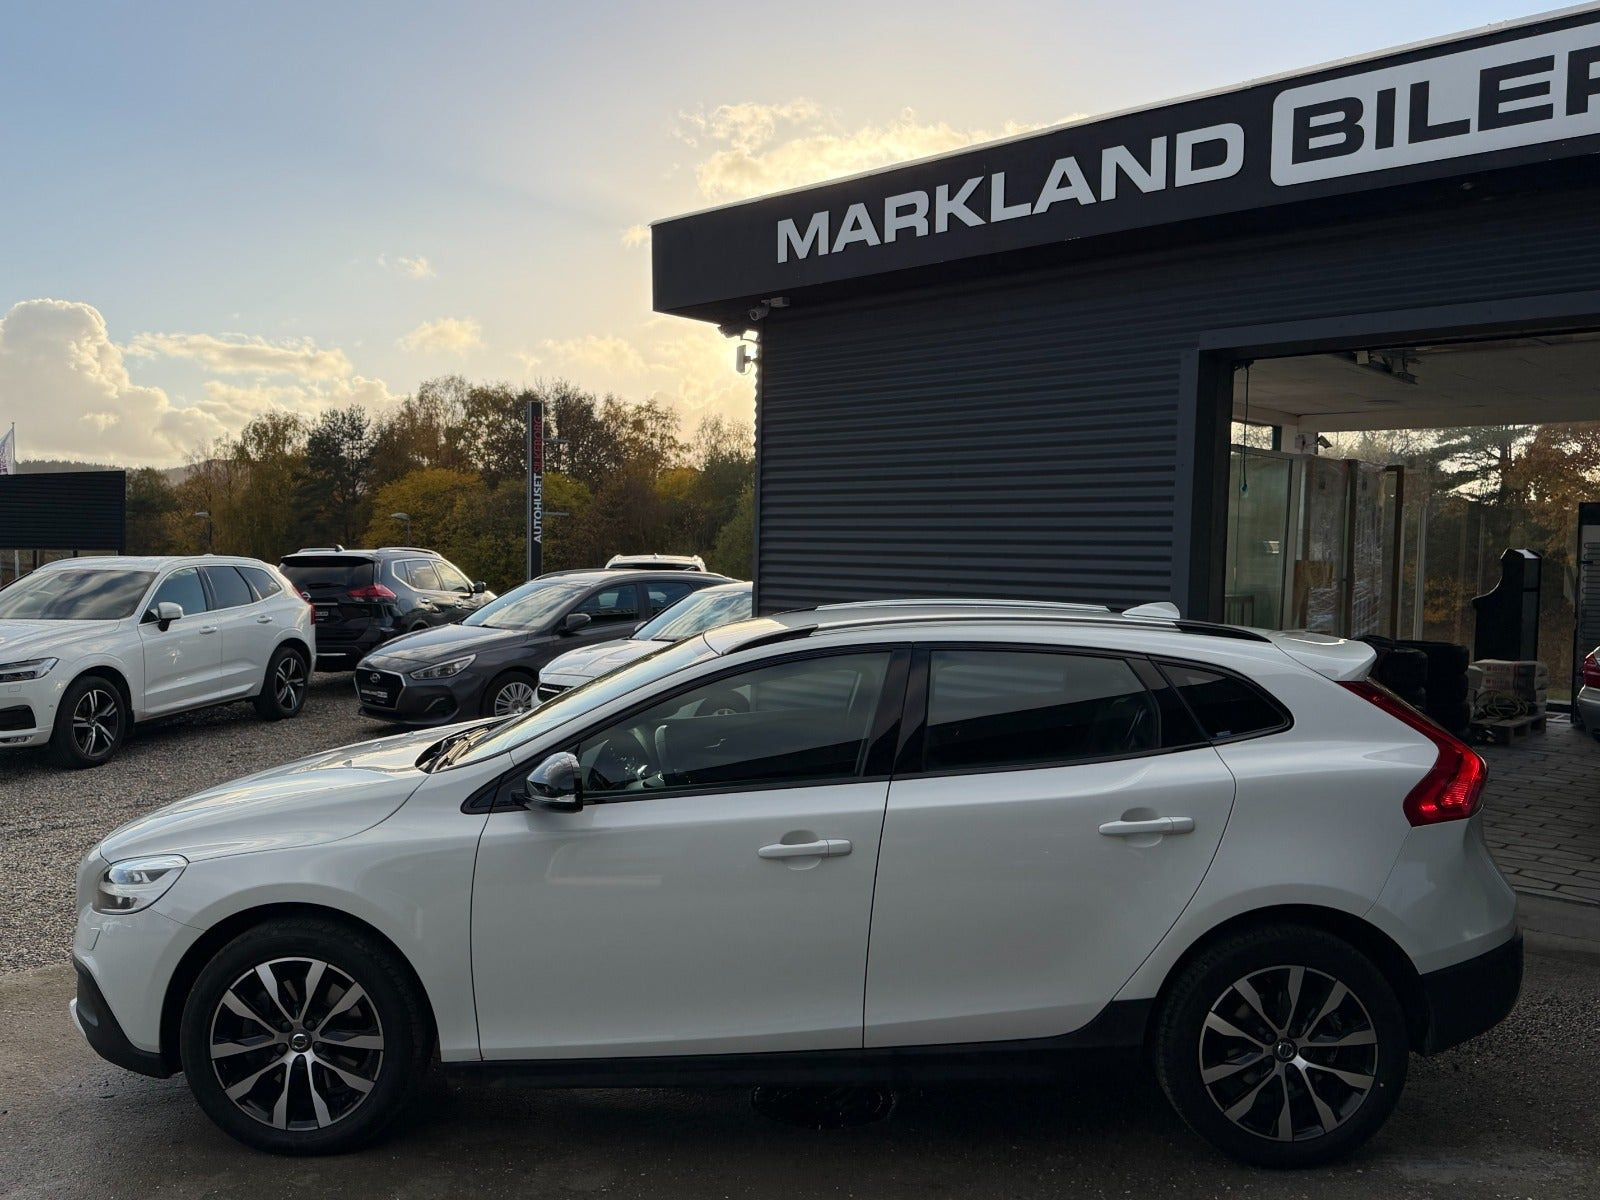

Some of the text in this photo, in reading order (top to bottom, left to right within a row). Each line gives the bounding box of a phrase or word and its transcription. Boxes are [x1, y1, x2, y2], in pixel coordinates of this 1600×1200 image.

[777, 122, 1245, 264] MARKLAND
[533, 416, 542, 543] AUTOHUSET SILKEBORG
